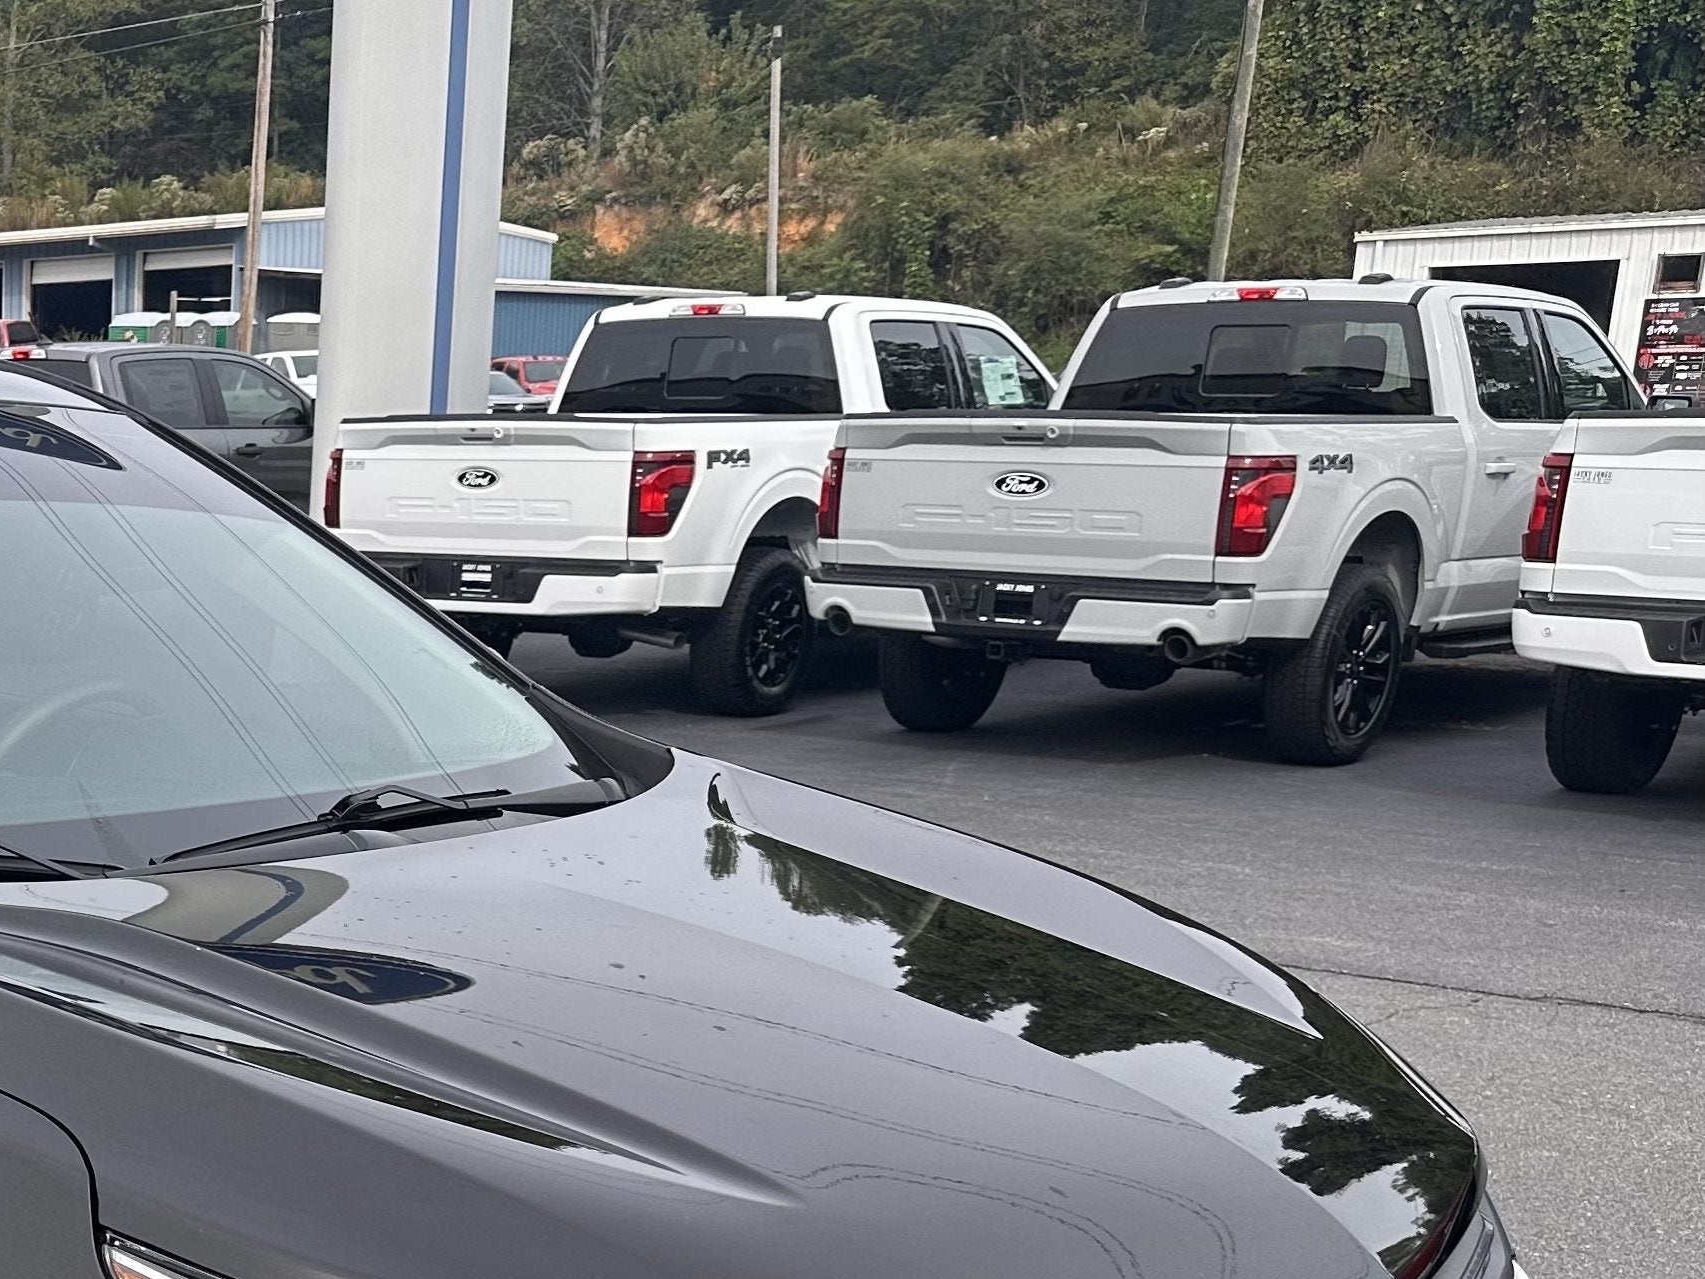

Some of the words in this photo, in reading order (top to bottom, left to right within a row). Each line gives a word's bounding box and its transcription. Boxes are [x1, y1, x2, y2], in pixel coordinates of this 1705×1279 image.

[706, 448, 751, 470] FX4
[462, 471, 492, 487] Ford
[1001, 475, 1039, 493] Ford
[386, 496, 572, 522] F-150
[898, 502, 1143, 537] F-150
